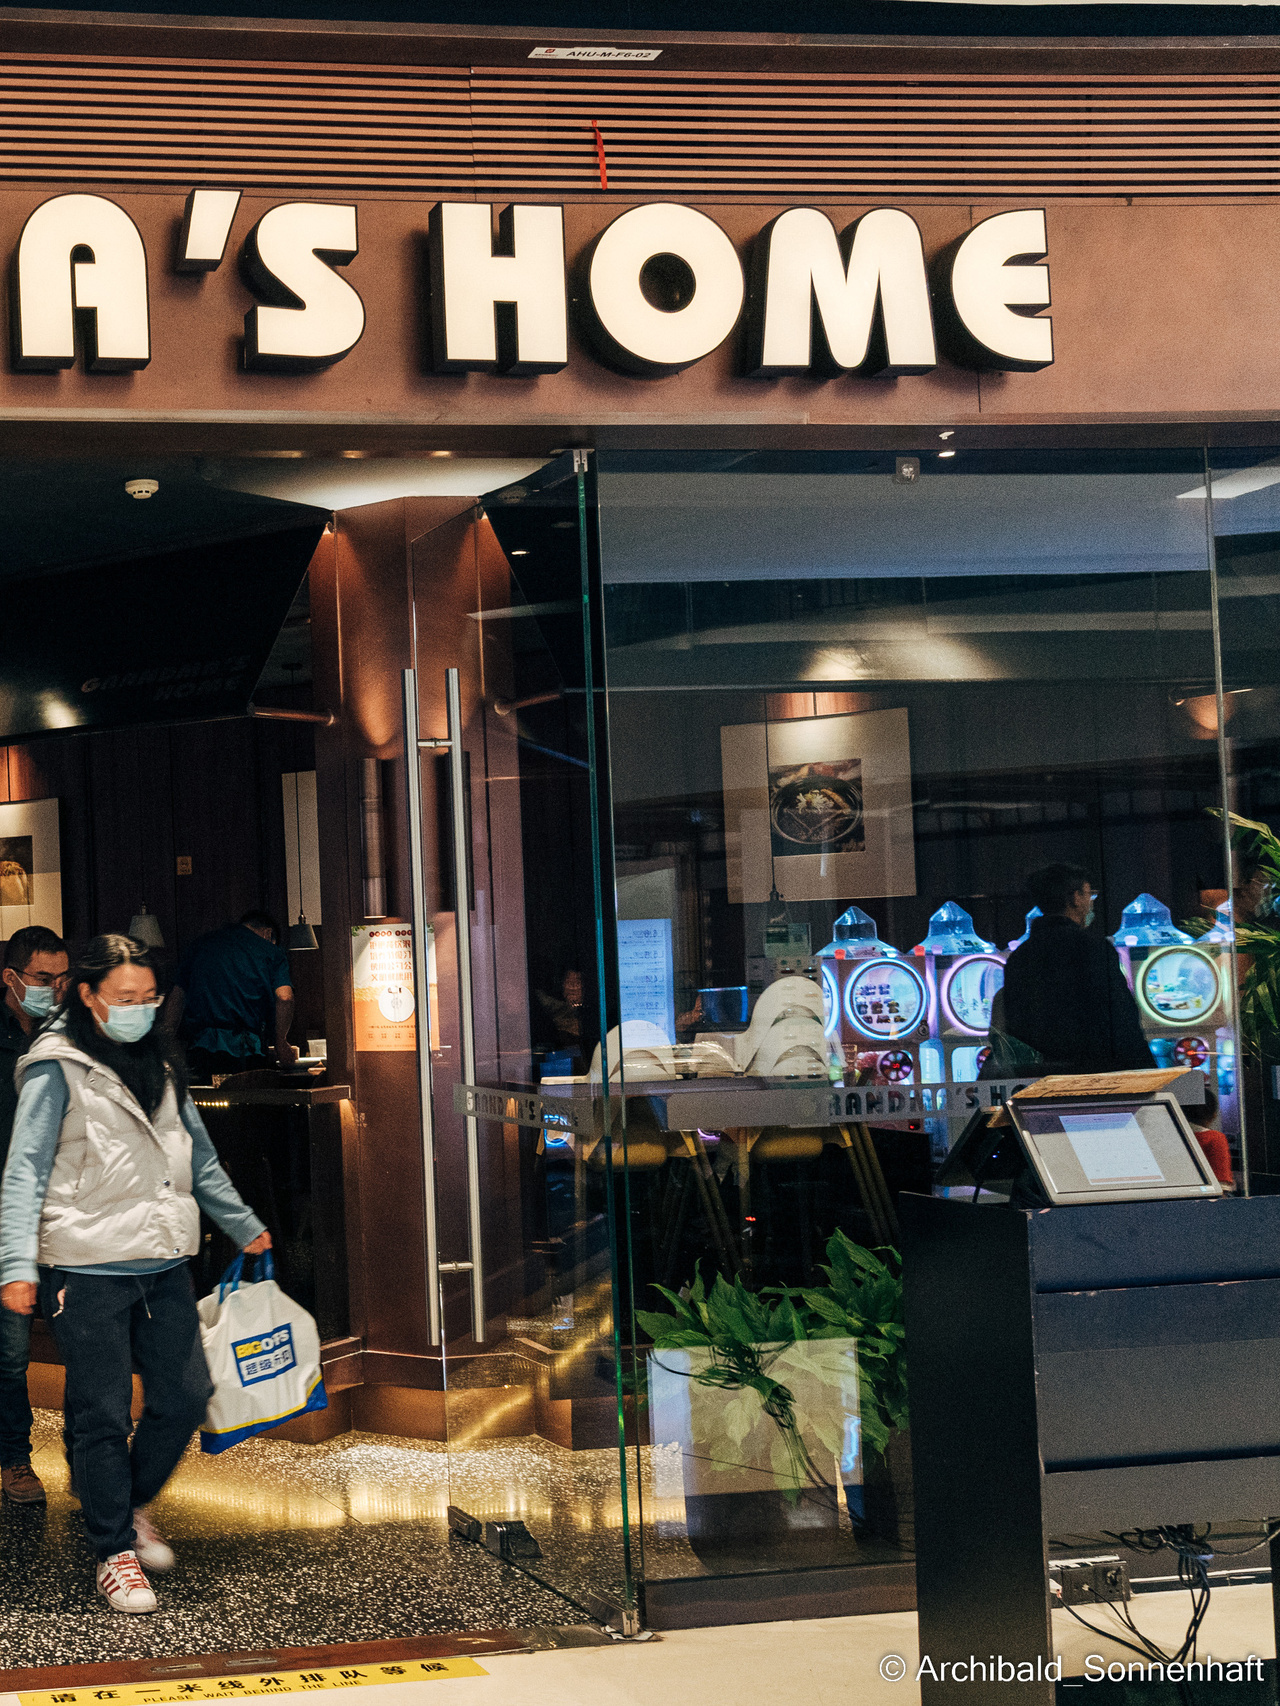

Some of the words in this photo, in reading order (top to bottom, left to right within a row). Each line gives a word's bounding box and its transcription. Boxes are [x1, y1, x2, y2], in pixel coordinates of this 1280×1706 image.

[566, 51, 652, 59] AHU-M-F6-02
[432, 202, 1055, 371] HOME
[51, 1662, 449, 1703] 请在一米线外排队等候
[144, 1694, 193, 1703] PLEASE
[203, 1690, 234, 1699] WAIT
[244, 1686, 292, 1695] BEHIND
